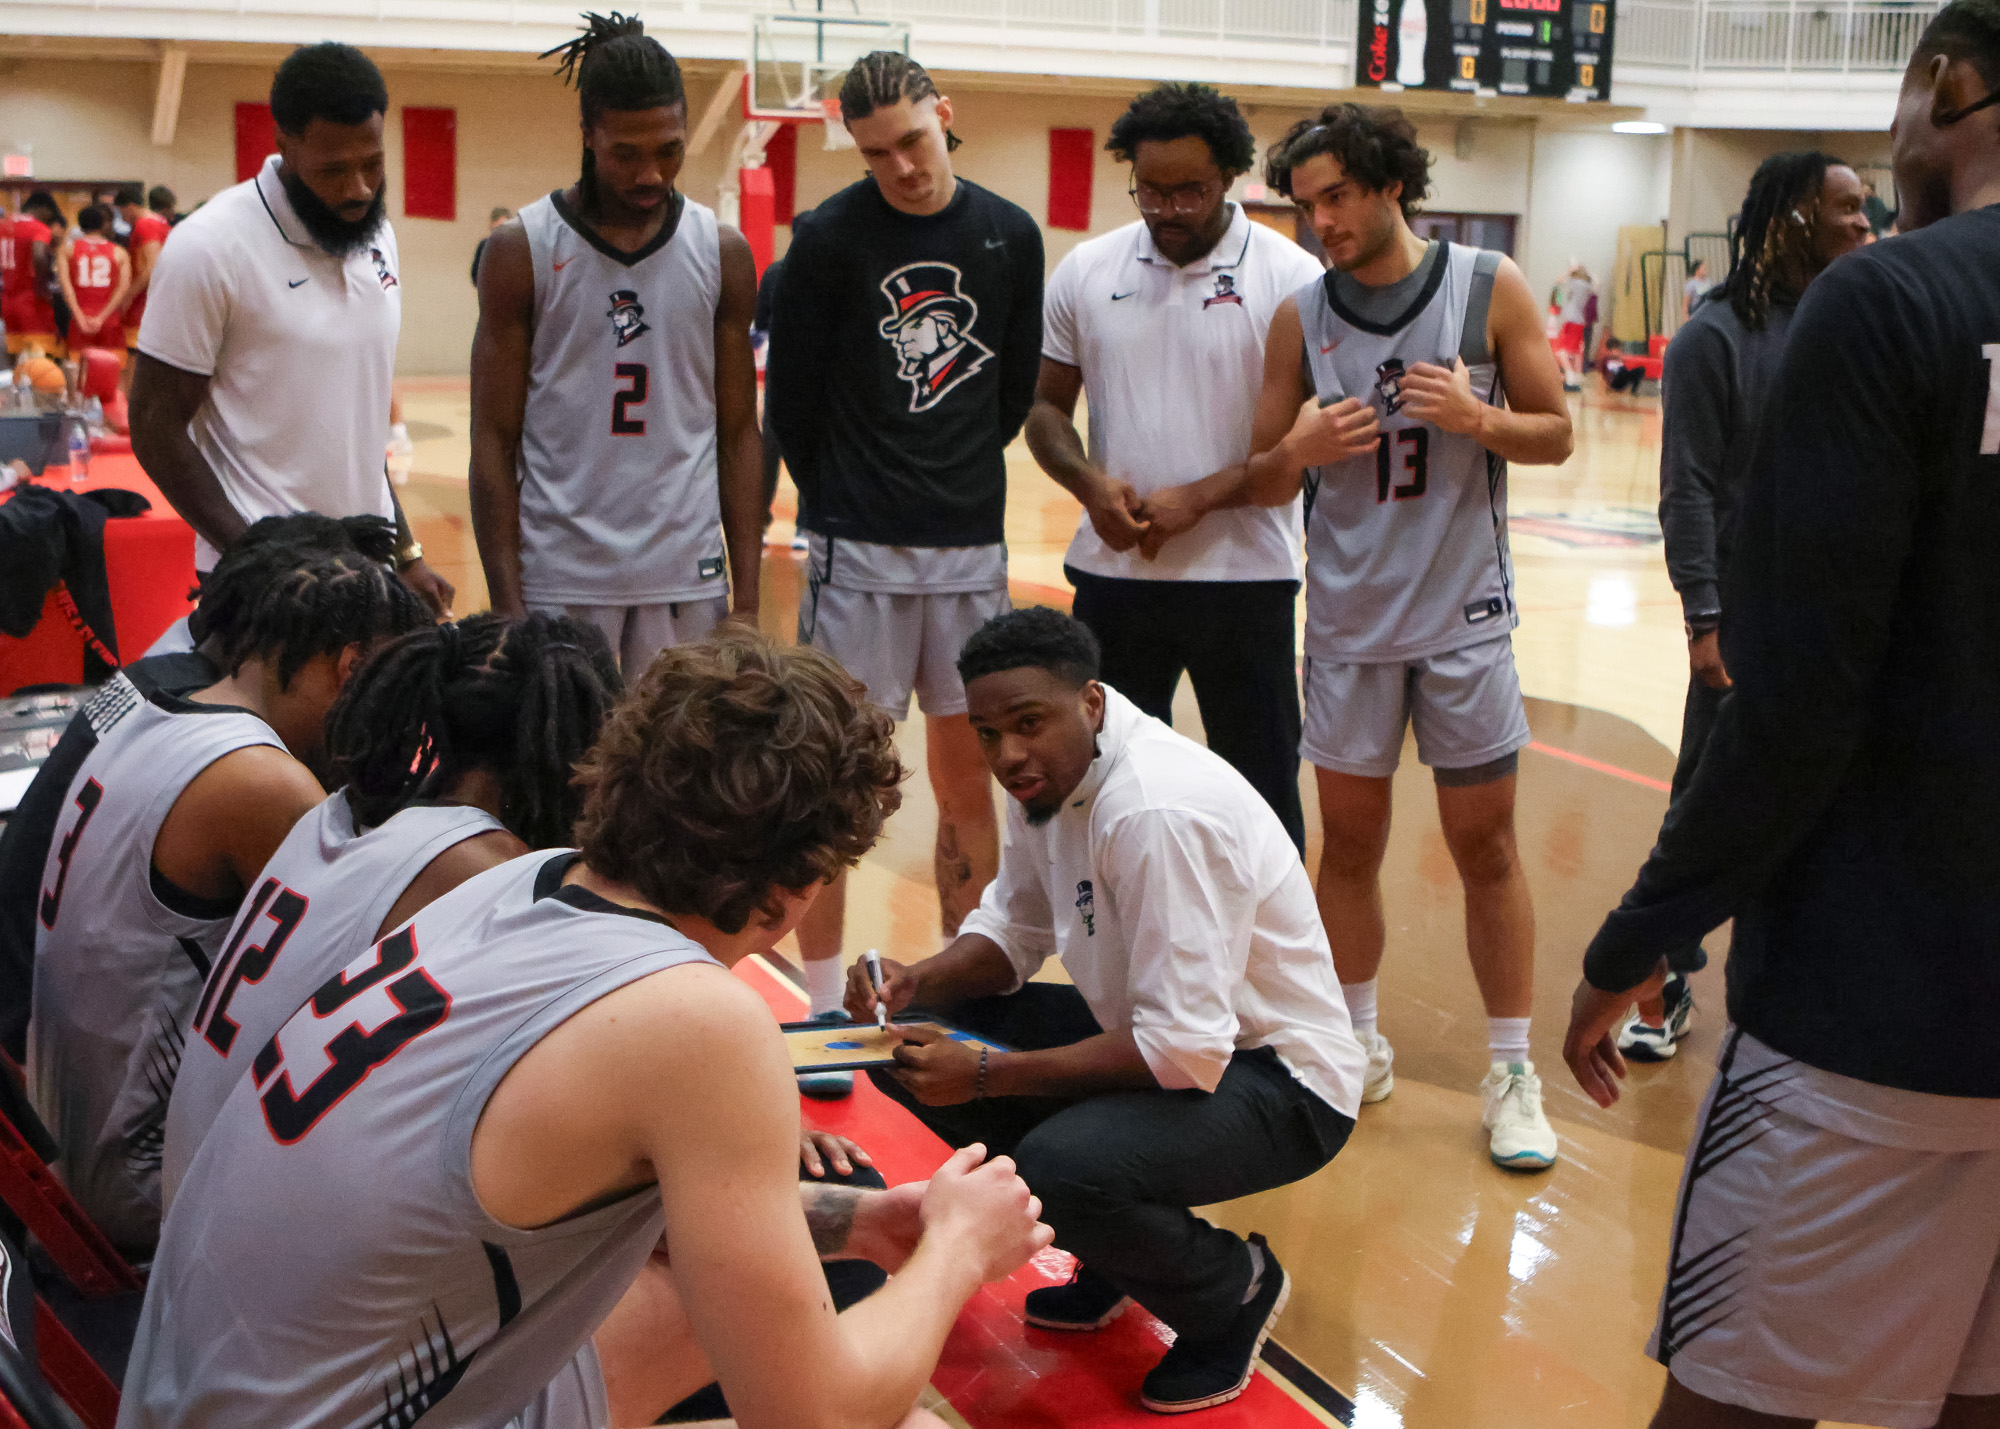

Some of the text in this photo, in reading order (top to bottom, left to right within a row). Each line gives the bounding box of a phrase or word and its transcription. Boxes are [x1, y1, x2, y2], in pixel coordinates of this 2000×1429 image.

[1368, 25, 1389, 82] Coke
[1590, 3, 1606, 34] 0
[77, 254, 111, 288] 12
[610, 362, 650, 437] 2
[1376, 425, 1428, 505] 13
[40, 776, 104, 931] 3
[193, 877, 309, 1059] 12
